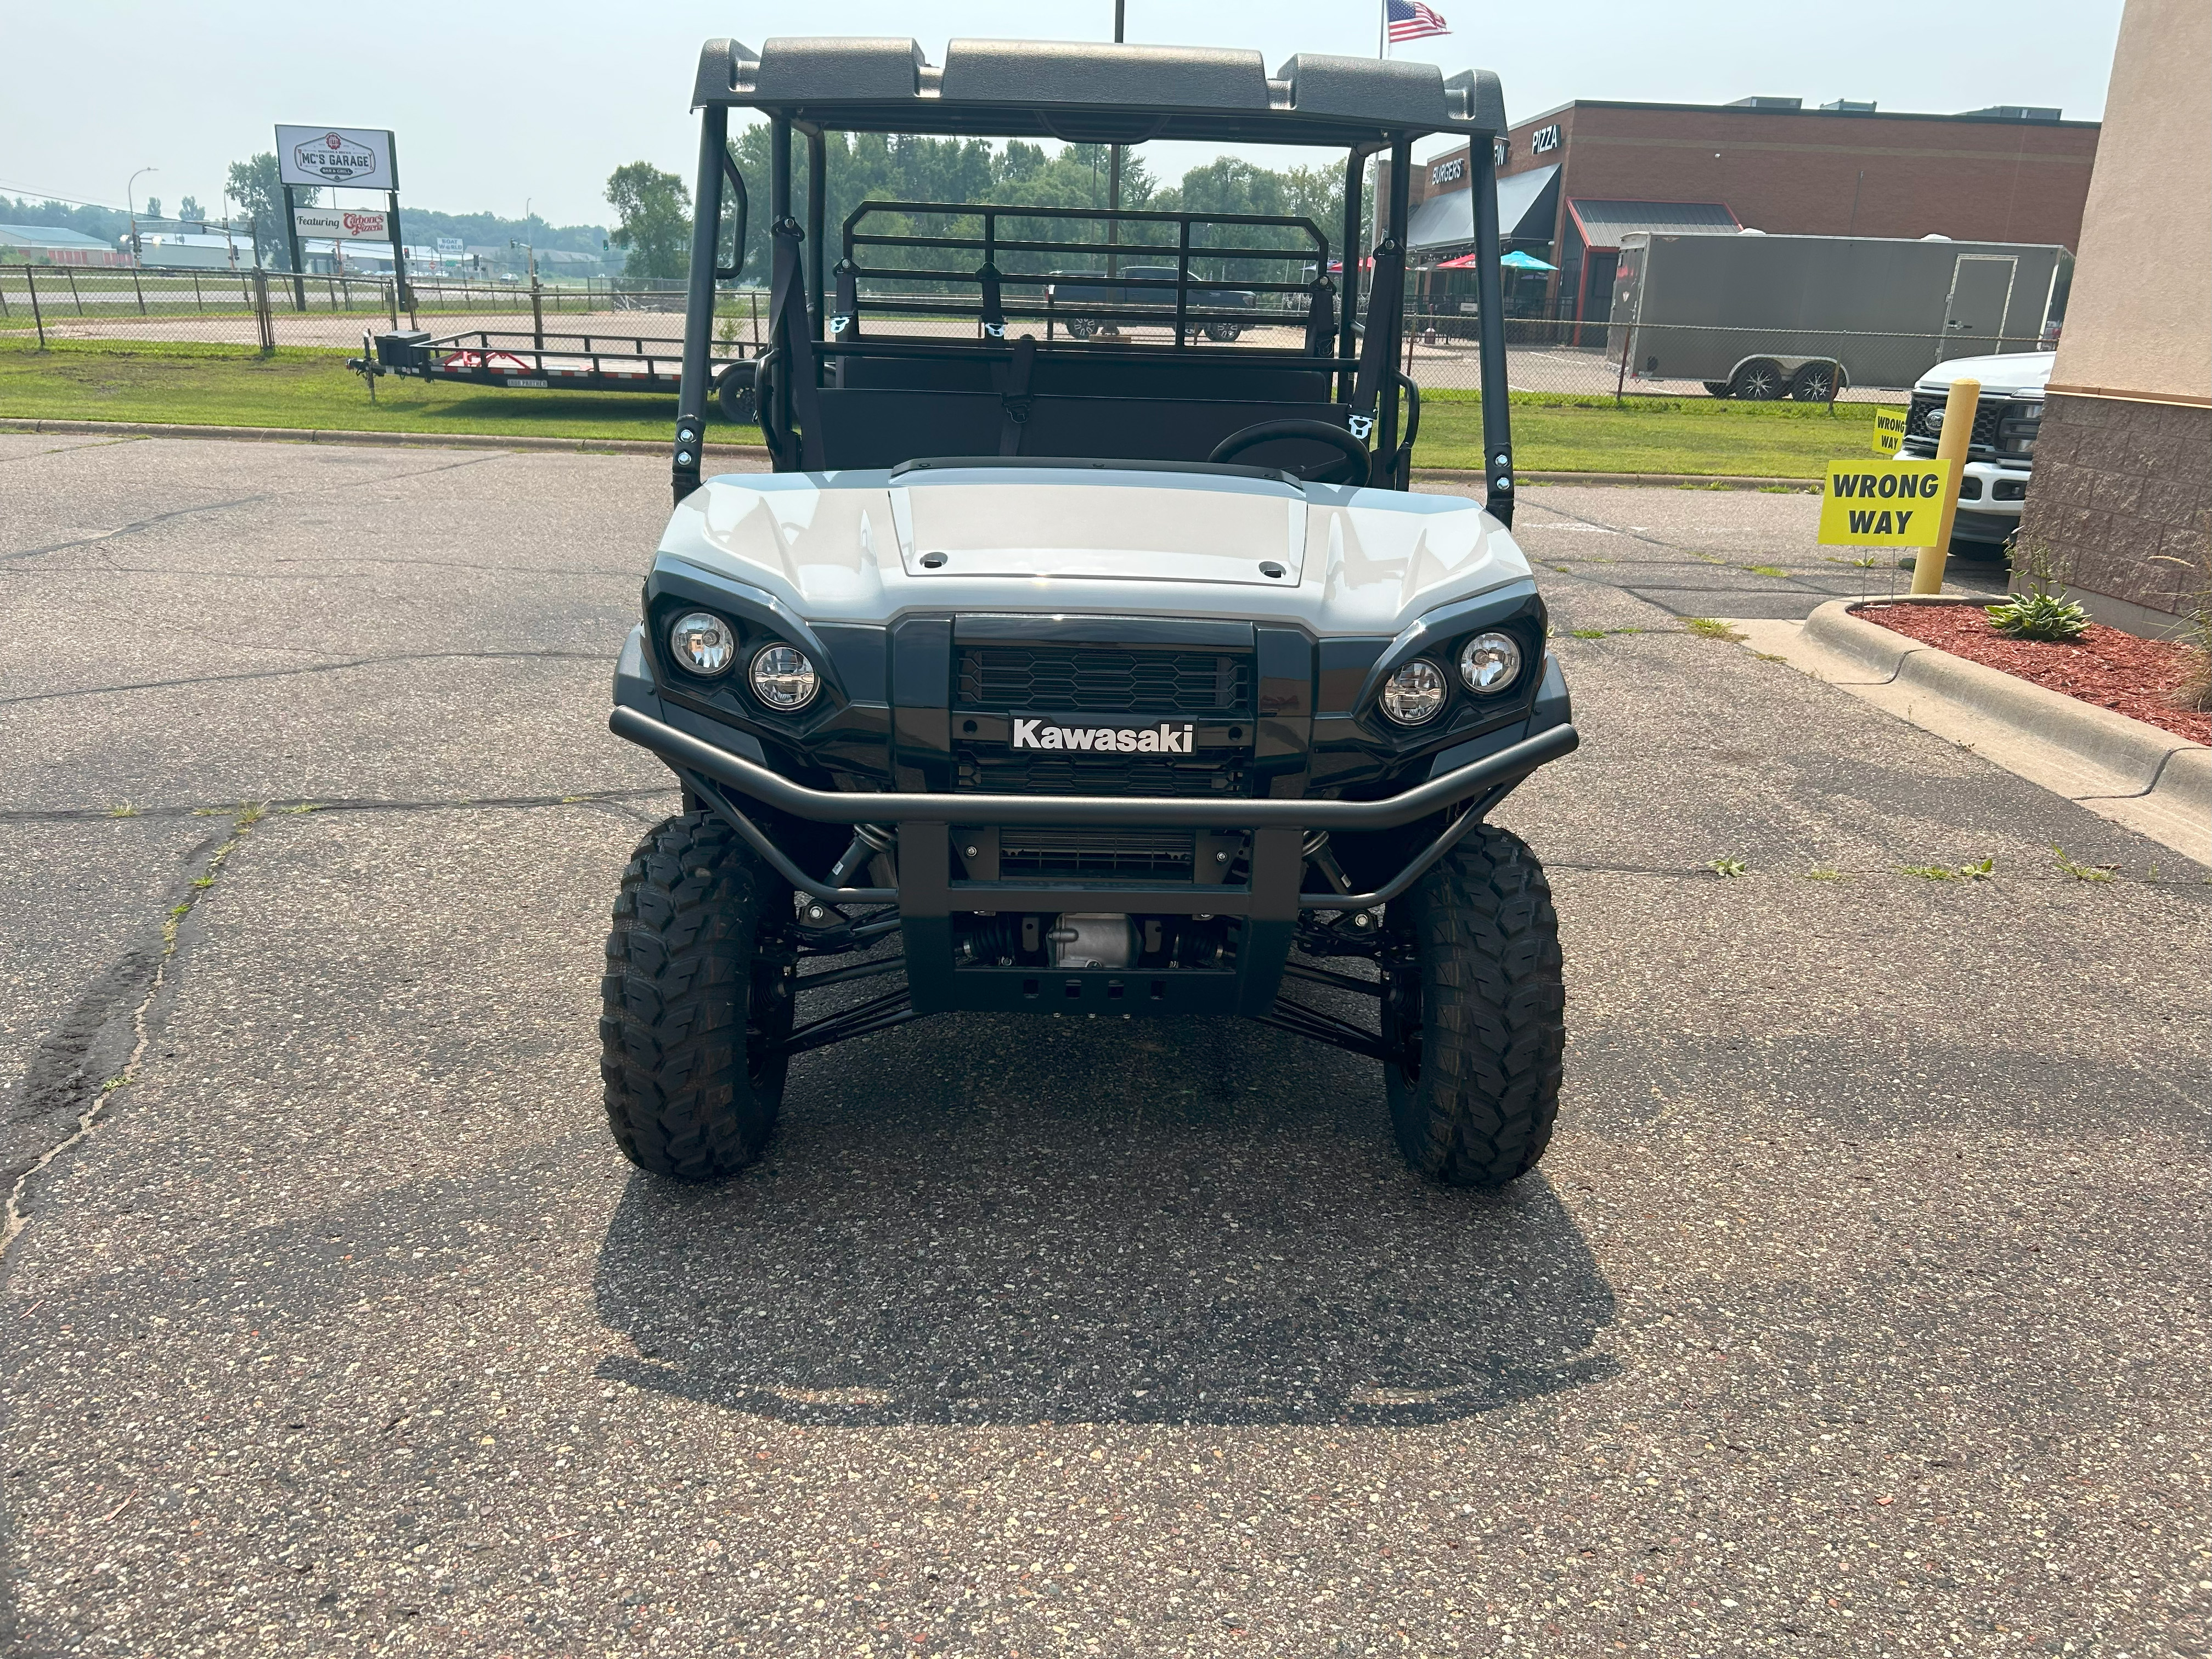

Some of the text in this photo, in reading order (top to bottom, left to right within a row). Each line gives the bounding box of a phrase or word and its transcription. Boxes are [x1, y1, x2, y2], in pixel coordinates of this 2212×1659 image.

[1532, 125, 1558, 155] PIZZA
[329, 154, 369, 167] GARAGE
[1432, 159, 1464, 185] BURGERS
[296, 216, 340, 229] Featuring
[1877, 416, 1905, 433] WRONG
[1881, 435, 1899, 450] WAY
[1833, 473, 1939, 498] WRONG
[1849, 510, 1913, 534] WAY
[1013, 719, 1194, 753] Kawasaki
